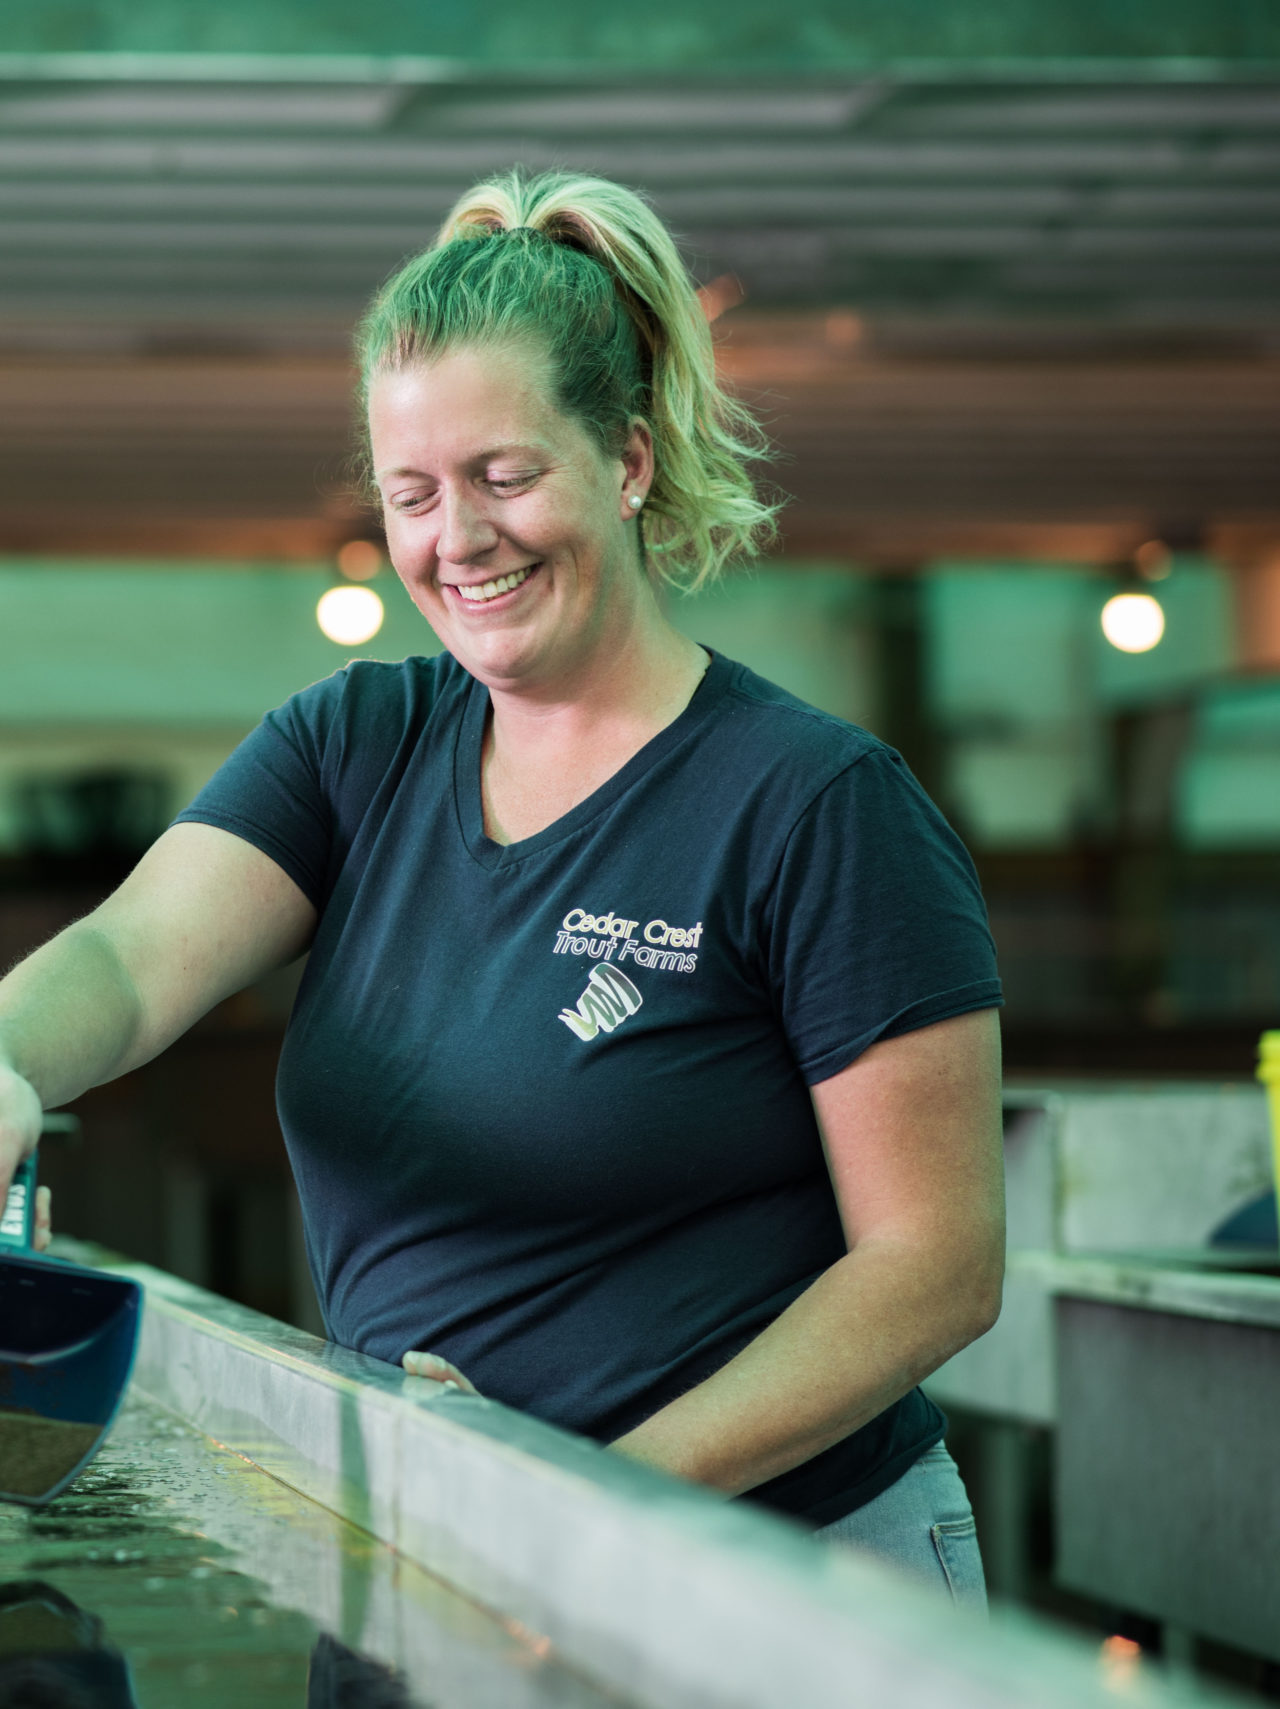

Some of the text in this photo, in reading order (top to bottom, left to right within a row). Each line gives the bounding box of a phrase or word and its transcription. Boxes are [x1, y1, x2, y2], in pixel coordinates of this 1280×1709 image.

[562, 908, 703, 948] Cedar Crest
[554, 932, 698, 973] Trout Farms
